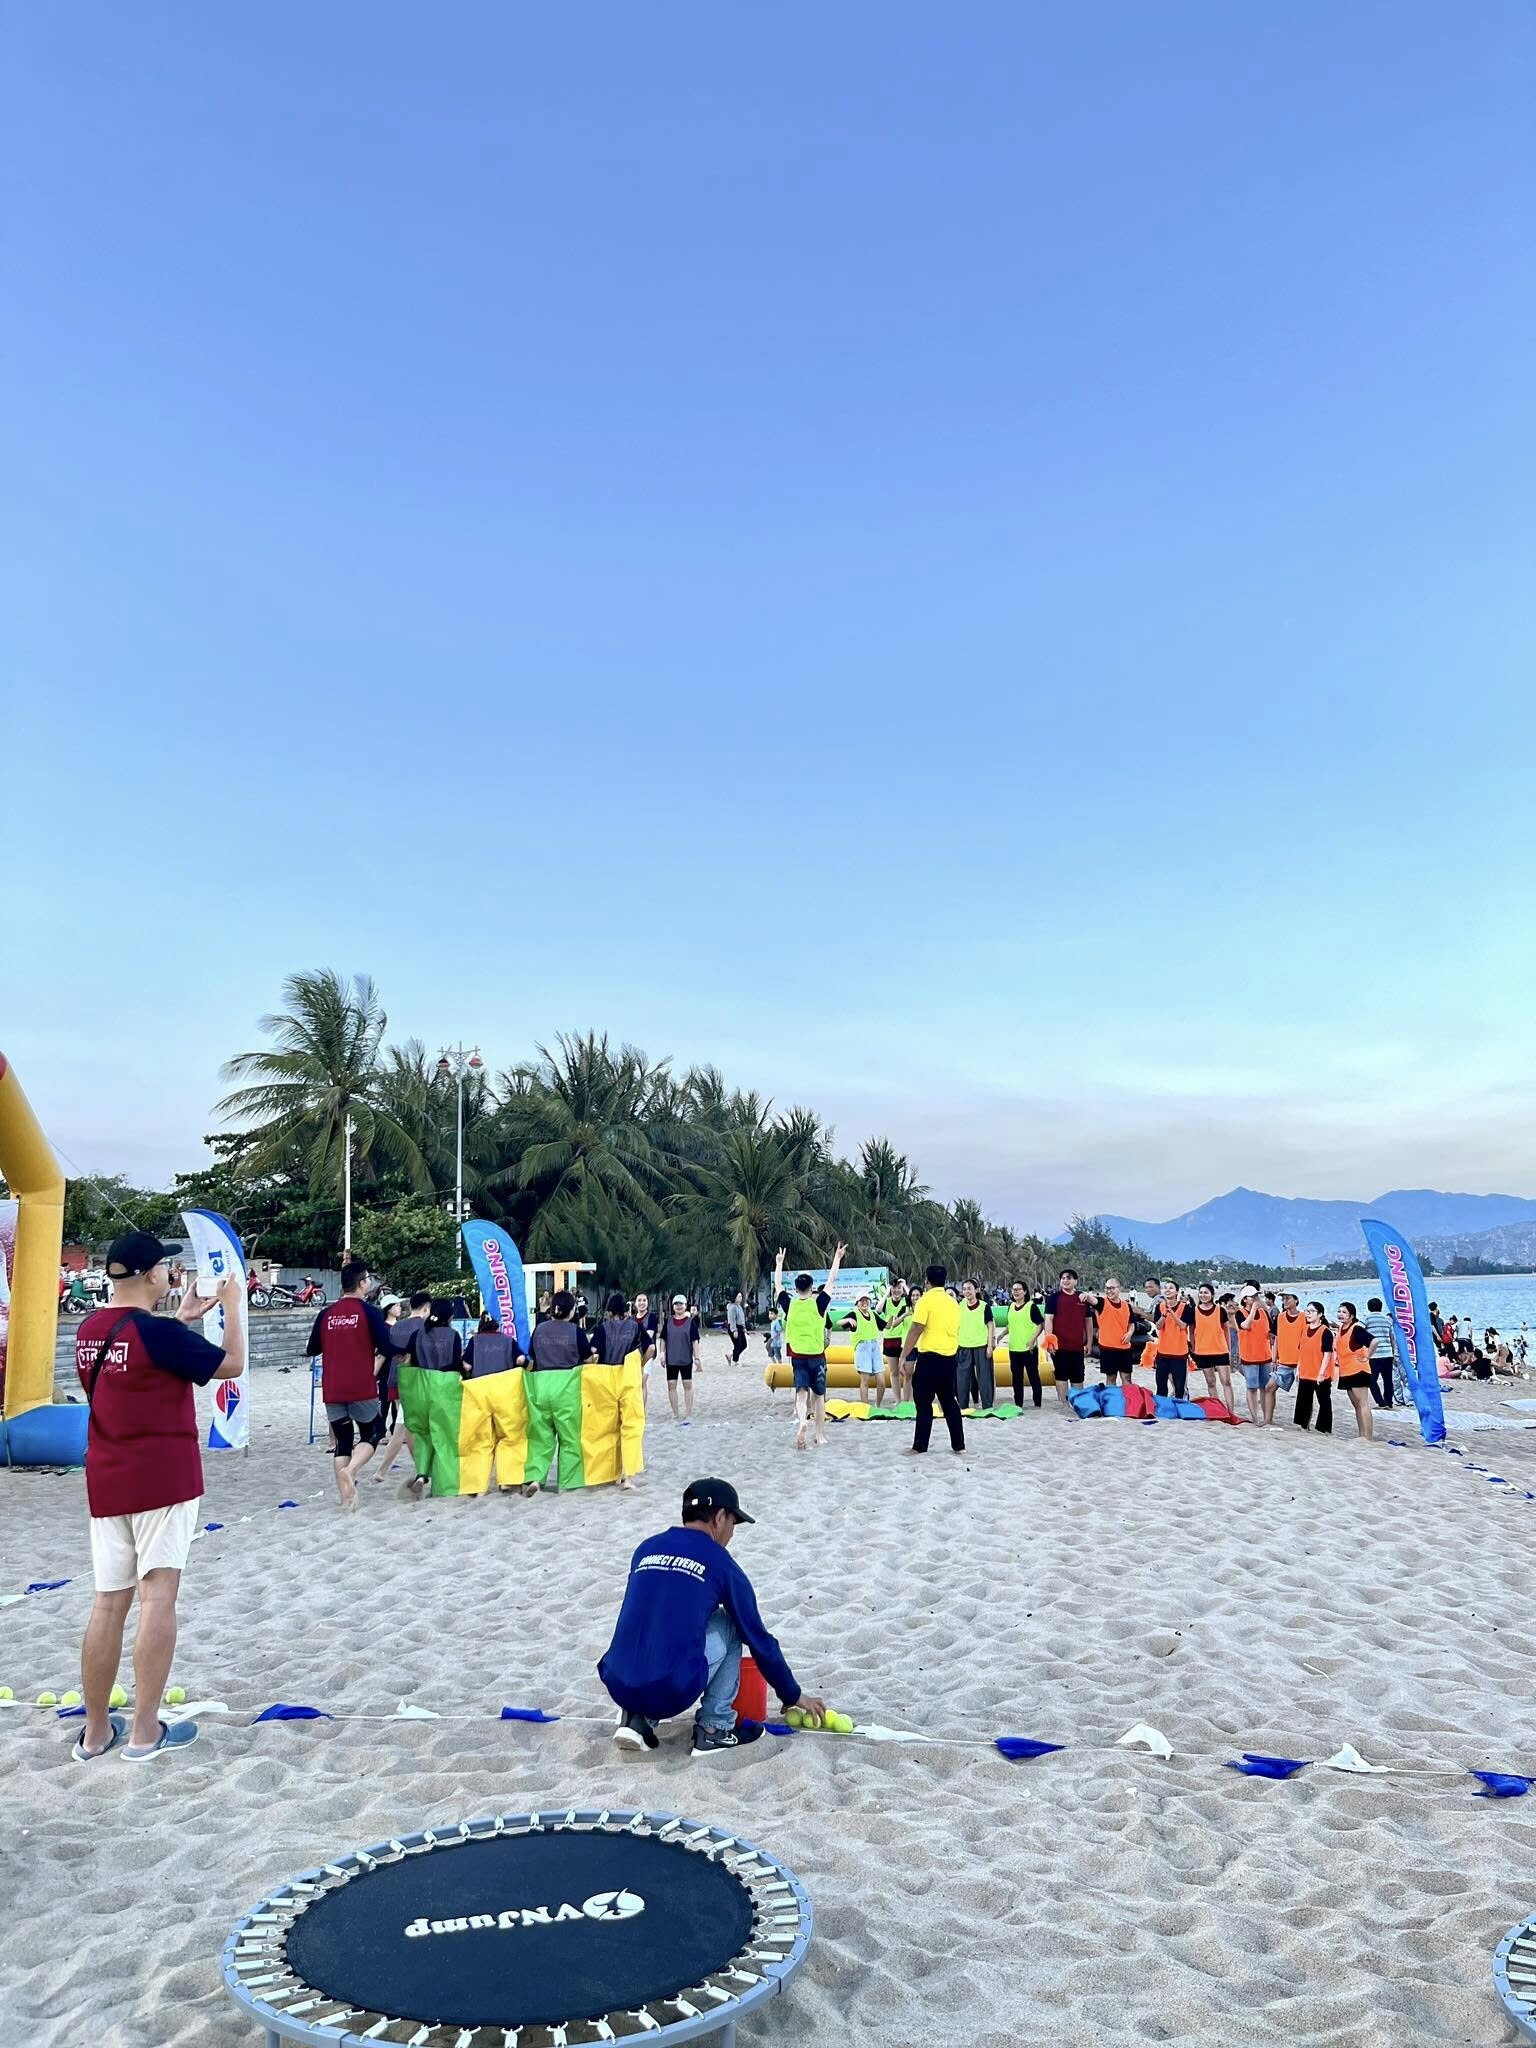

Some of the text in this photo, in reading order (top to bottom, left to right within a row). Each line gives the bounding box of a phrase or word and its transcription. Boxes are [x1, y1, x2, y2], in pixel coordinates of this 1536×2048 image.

[79, 1347, 123, 1364] STRNG
[671, 1556, 706, 1575] EVENTS
[404, 1902, 585, 1938] VNJump
